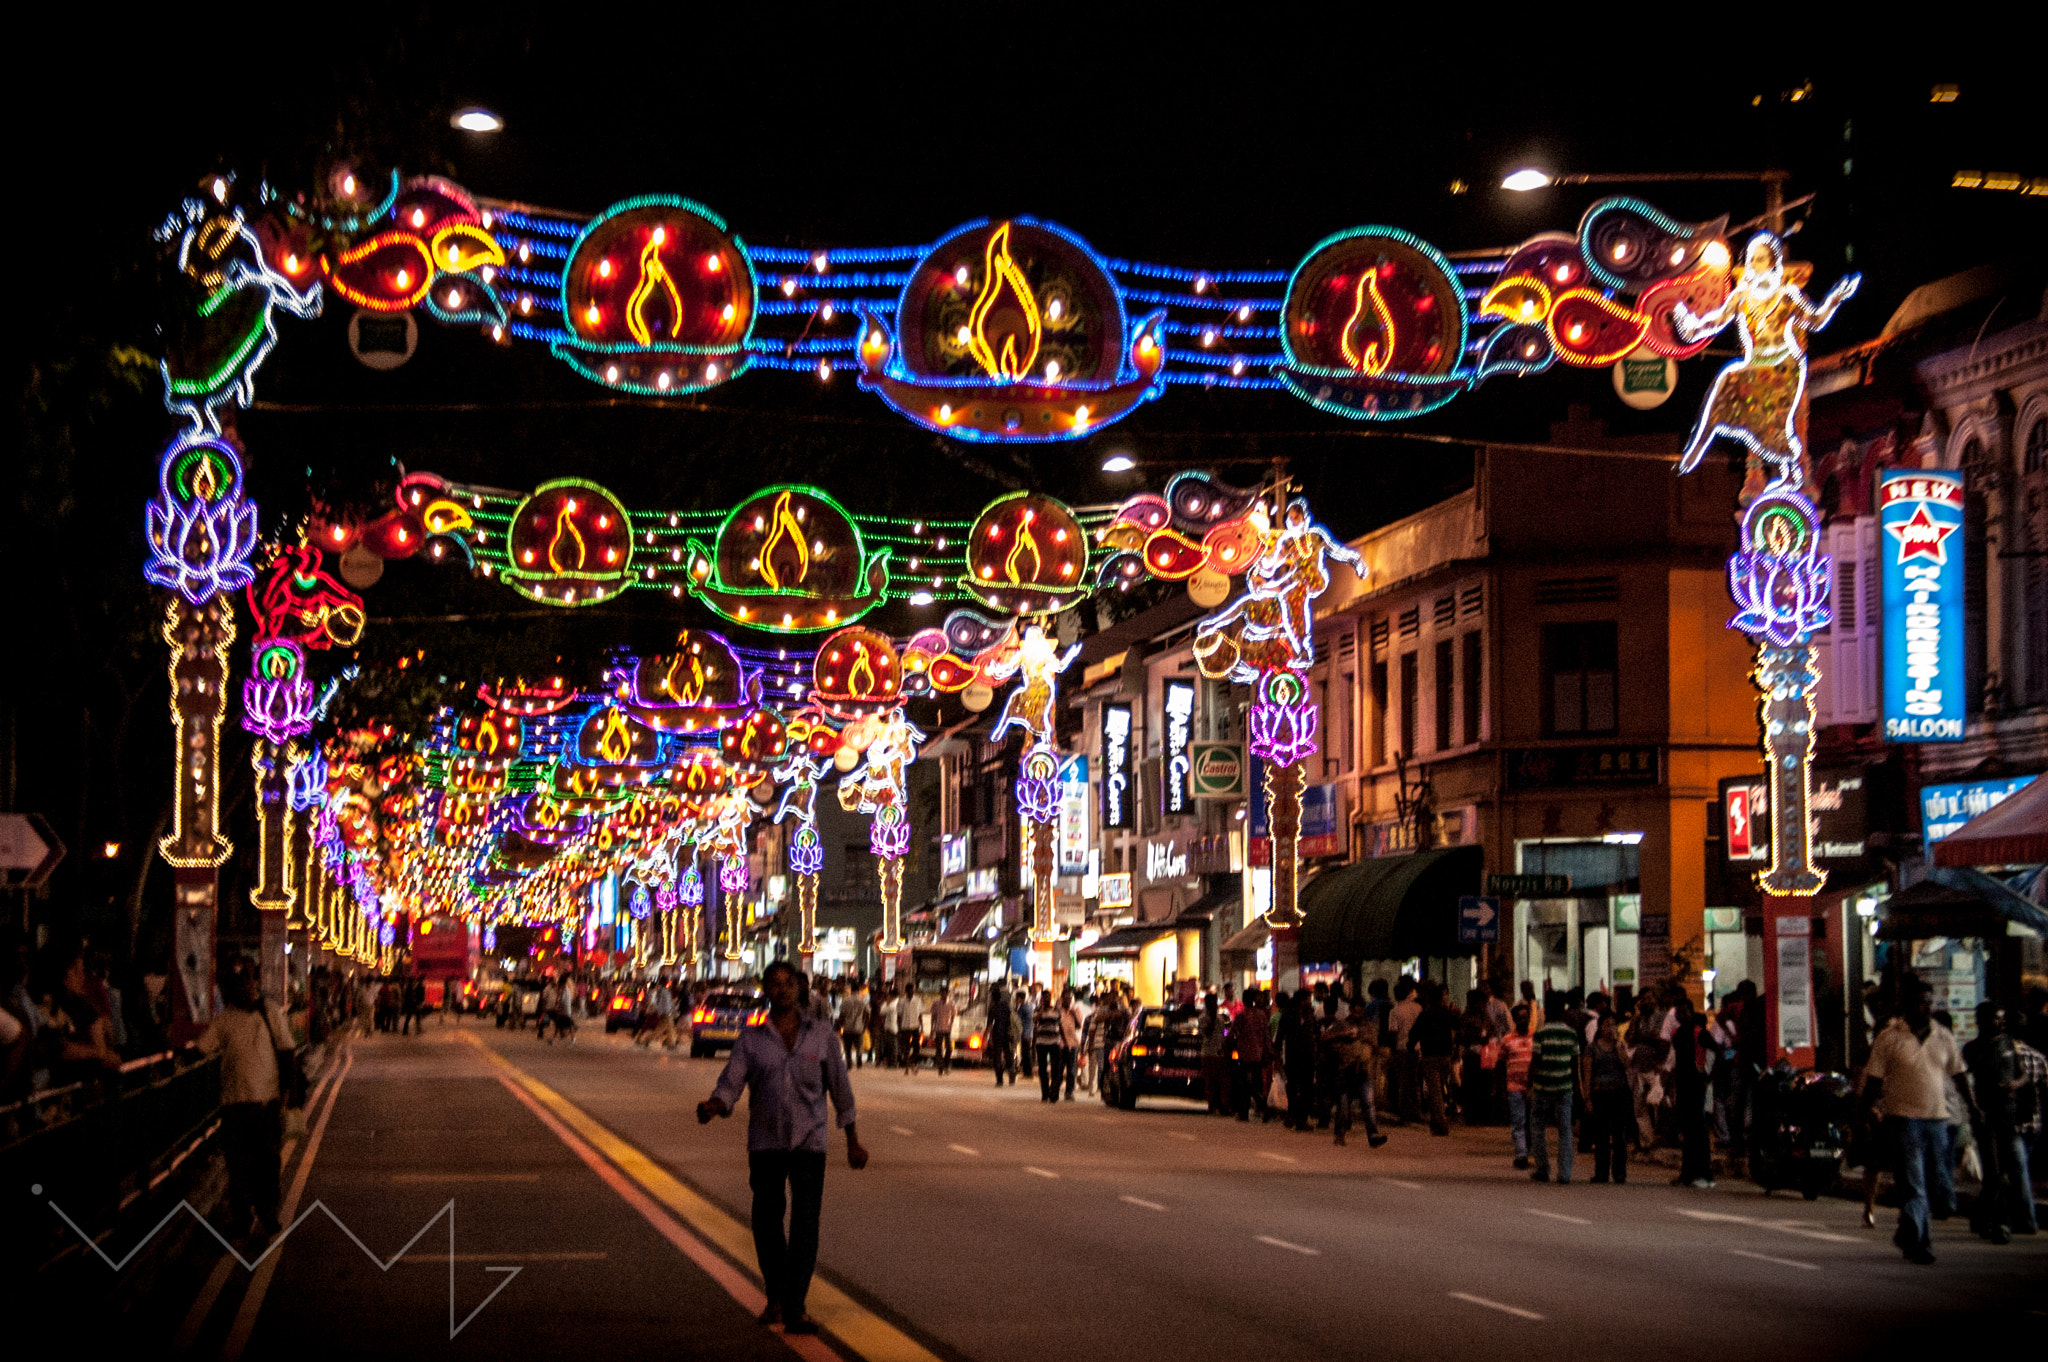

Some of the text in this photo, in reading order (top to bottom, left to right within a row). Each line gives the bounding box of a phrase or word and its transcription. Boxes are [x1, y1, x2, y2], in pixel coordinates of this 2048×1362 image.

[1888, 482, 1956, 500] NEW
[1902, 525, 1941, 544] STAR
[1886, 718, 1963, 738] SALOON
[1203, 763, 1237, 775] Castrol
[1490, 875, 1562, 892] Norris Rd
